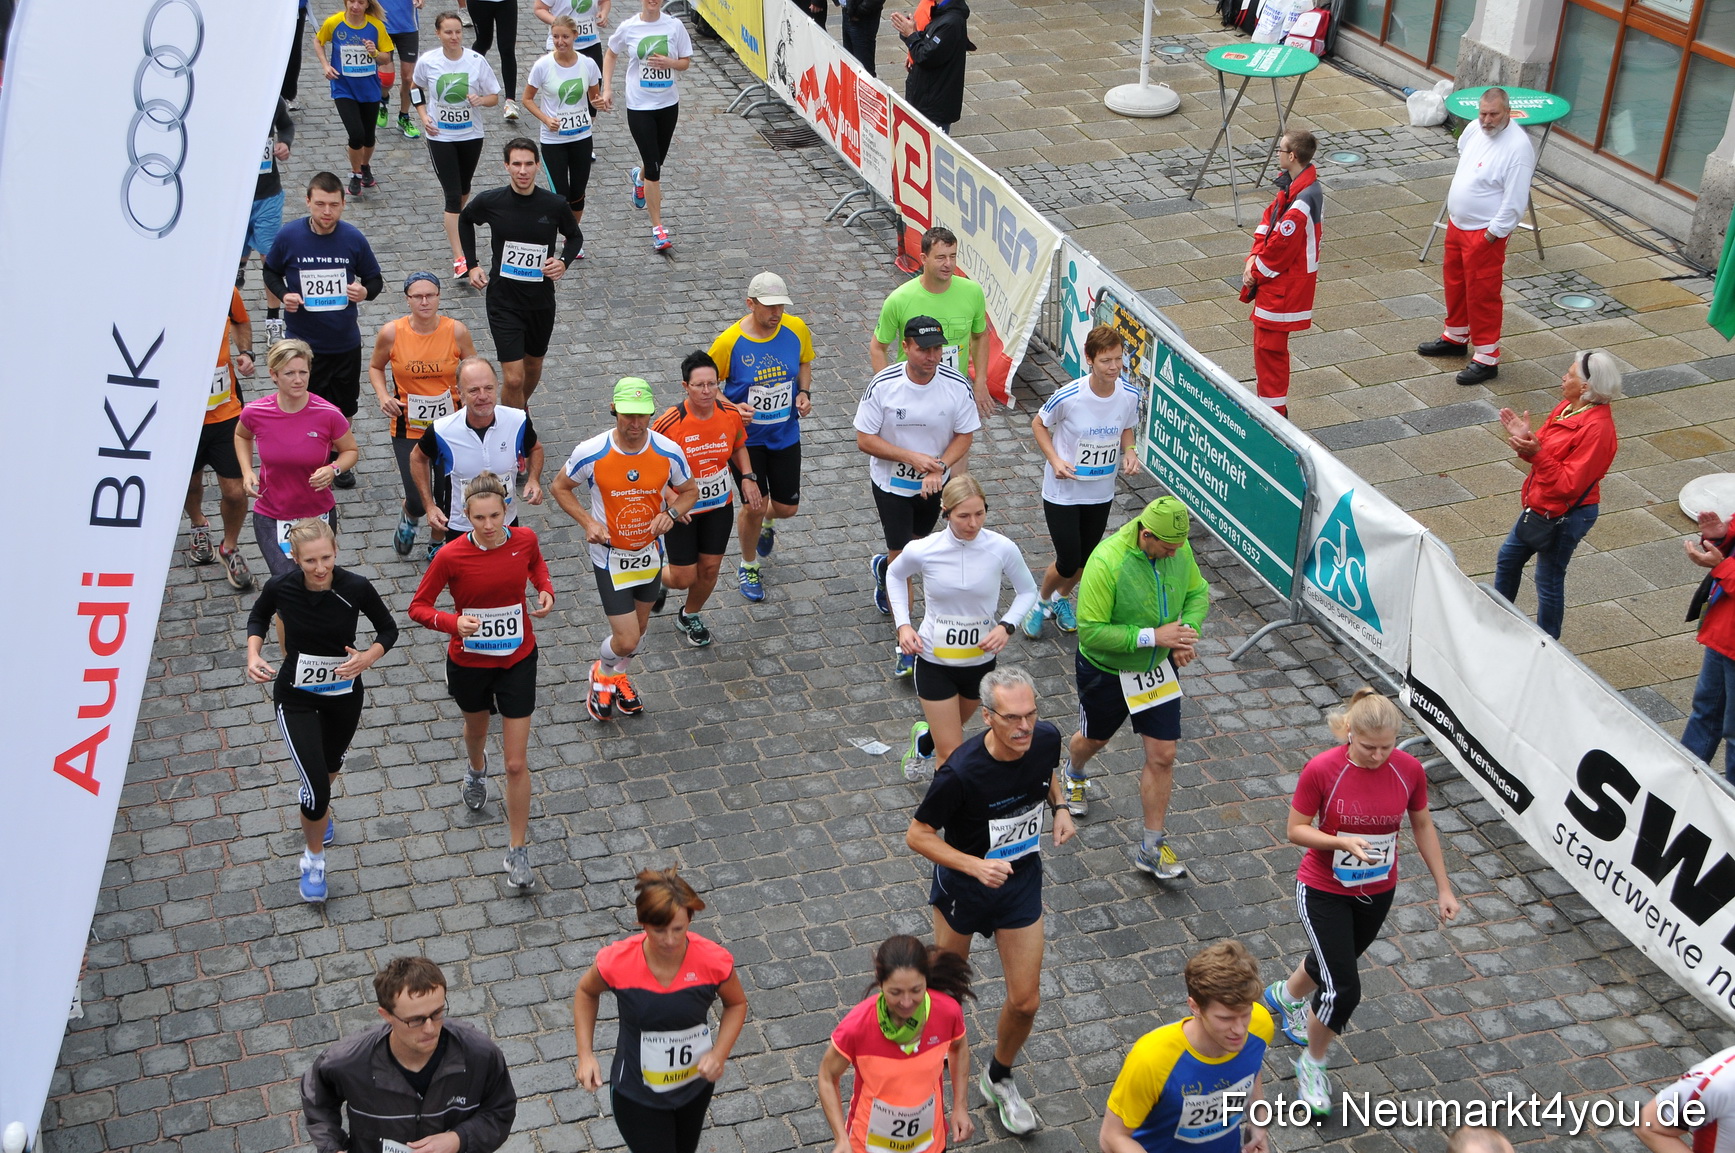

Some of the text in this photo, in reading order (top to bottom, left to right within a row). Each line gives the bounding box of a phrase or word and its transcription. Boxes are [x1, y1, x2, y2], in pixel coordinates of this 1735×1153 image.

[345, 54, 373, 65] 2128
[642, 68, 671, 79] 2360
[440, 110, 470, 123] 2659
[561, 114, 588, 129] 2134
[506, 251, 542, 268] 2781
[513, 268, 533, 276] Robert
[306, 280, 342, 295] 2841
[412, 364, 442, 373] OEXL
[753, 392, 788, 410] 2872
[1178, 373, 1246, 440] Event-Leit-Systeme
[418, 403, 447, 419] 275
[1089, 426, 1118, 435] heinloth
[686, 441, 728, 453] SportScheck
[1156, 394, 1247, 489] Mehr Sicherheit
[1080, 449, 1116, 465] 2110
[1154, 420, 1228, 501] für Ihr Event!
[611, 488, 657, 497] SportScheck
[698, 479, 727, 499] 931
[1151, 455, 1261, 564] Miet & Service Line: 09181 6352
[619, 528, 650, 536] Nürnbe
[53, 321, 166, 796] Audi BKK
[620, 554, 651, 569] 629
[1307, 586, 1382, 650] Gebäude Service GmbH
[946, 628, 979, 645] 600
[303, 667, 343, 683] 291
[1133, 666, 1164, 690] 139
[1410, 687, 1519, 802] istungen, die verbinden
[1000, 844, 1026, 856] Werner
[1564, 748, 1735, 956] SW
[1552, 823, 1704, 970] stadtwerke
[669, 1032, 700, 1044] Neumarkt
[665, 1045, 692, 1067] 16
[663, 1071, 689, 1083] Astrid
[873, 1103, 927, 1118] PARTL Neumarkt
[891, 1118, 920, 1137] 26
[890, 1141, 915, 1151] Diana
